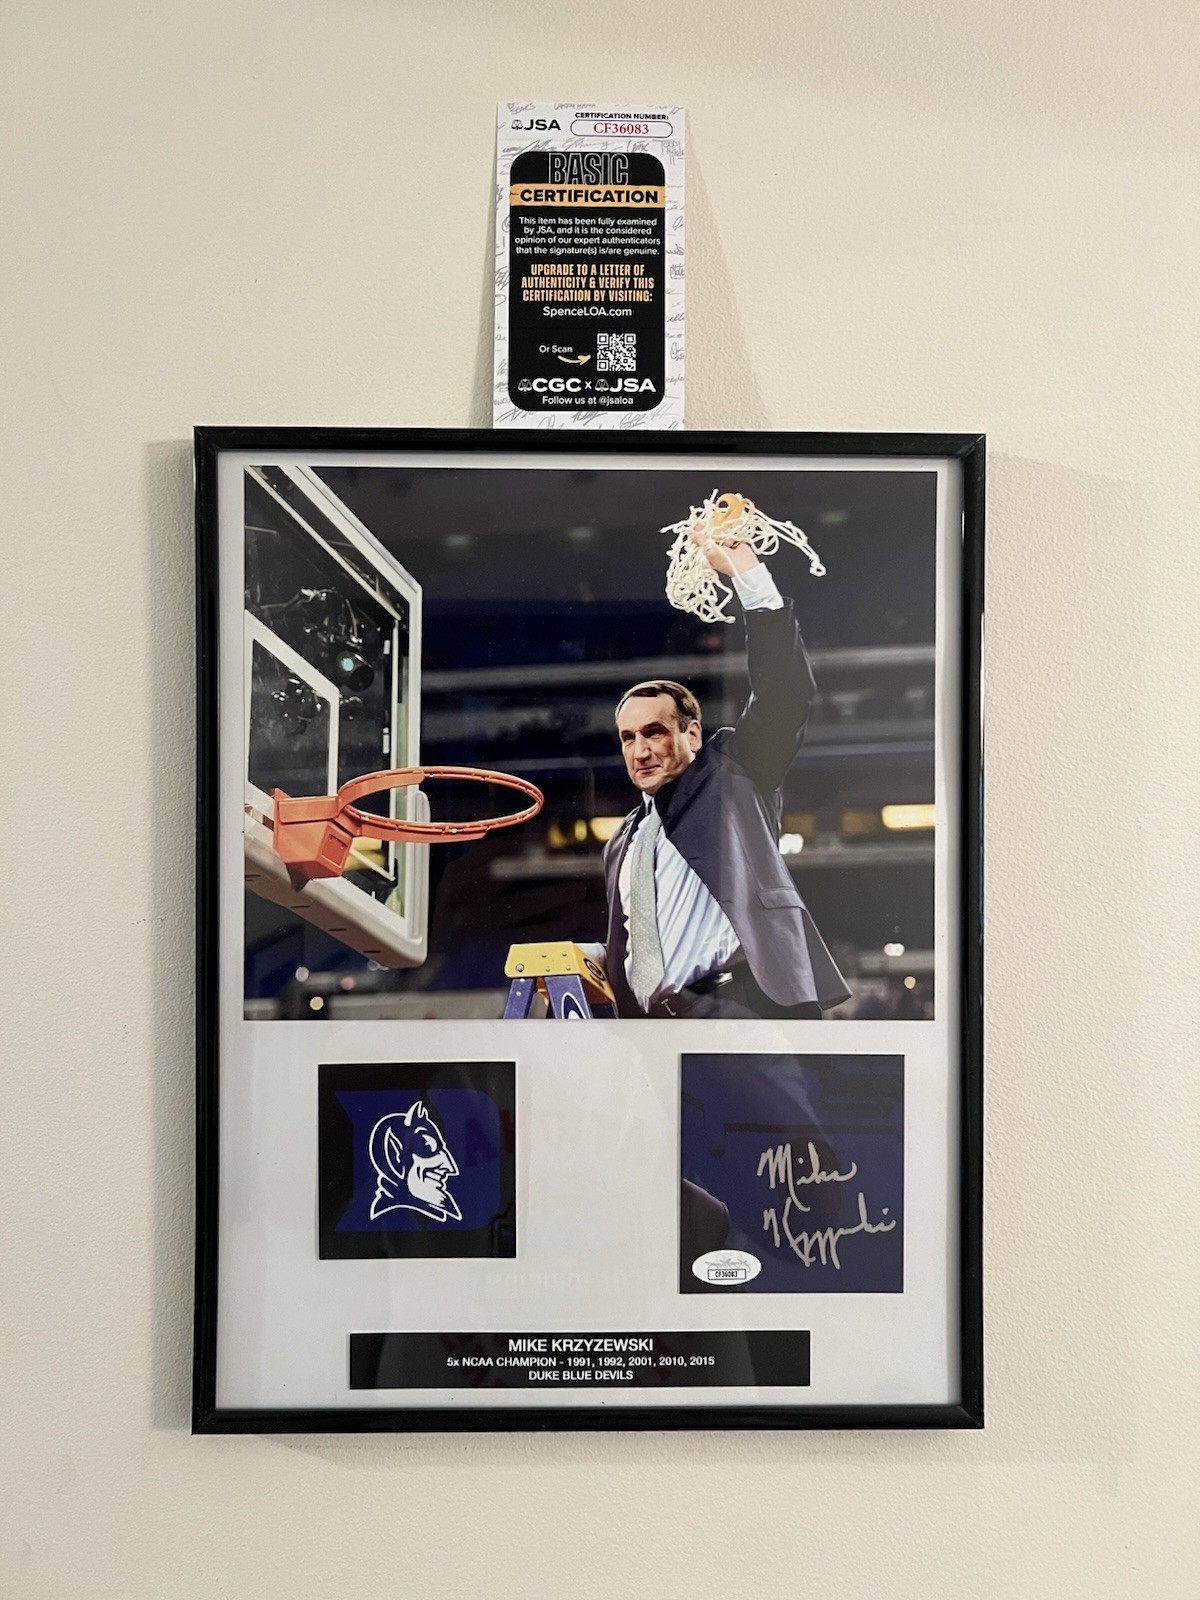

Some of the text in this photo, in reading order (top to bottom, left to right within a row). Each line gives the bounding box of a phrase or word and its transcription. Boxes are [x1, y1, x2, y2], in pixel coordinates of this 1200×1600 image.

[523, 119, 561, 131] JSA
[593, 122, 649, 134] CF36083
[549, 153, 628, 185] BASIC
[520, 189, 658, 203] CERTIFICATION
[519, 217, 657, 227] This item has been fully examined
[524, 226, 652, 235] by JSA, and it is the considered
[515, 236, 546, 246] opinion
[548, 236, 556, 245] of
[574, 237, 600, 246] expert
[602, 236, 661, 245] authenticators
[516, 246, 660, 257] that the signature(s) is/are genuine.
[531, 264, 645, 276] UPGRADE TO A LETTER OF
[521, 277, 654, 289] AUTHENTICITY & VERIFY THIS
[522, 290, 653, 302] CERTIFICATION BY VISITING:
[543, 306, 632, 318] SpenceLOA.com
[539, 345, 573, 353] Or Scan
[532, 378, 582, 392] CGC
[609, 378, 656, 392] JSA
[542, 396, 572, 404] Follow
[588, 396, 597, 404] at
[598, 396, 634, 406] @jsaloa
[509, 1338, 653, 1352] MIKE KRZYZEWSKI
[447, 1357, 459, 1367] 5x
[462, 1357, 493, 1367] NCAA
[496, 1357, 557, 1367] CHAMPION
[567, 1357, 595, 1368] 1991,
[599, 1357, 626, 1368] 1992,
[628, 1357, 656, 1368] 2001,
[659, 1356, 687, 1367] 2010,
[690, 1356, 715, 1366] 2015
[528, 1370, 633, 1381] DUKE BLUE DEVILS
